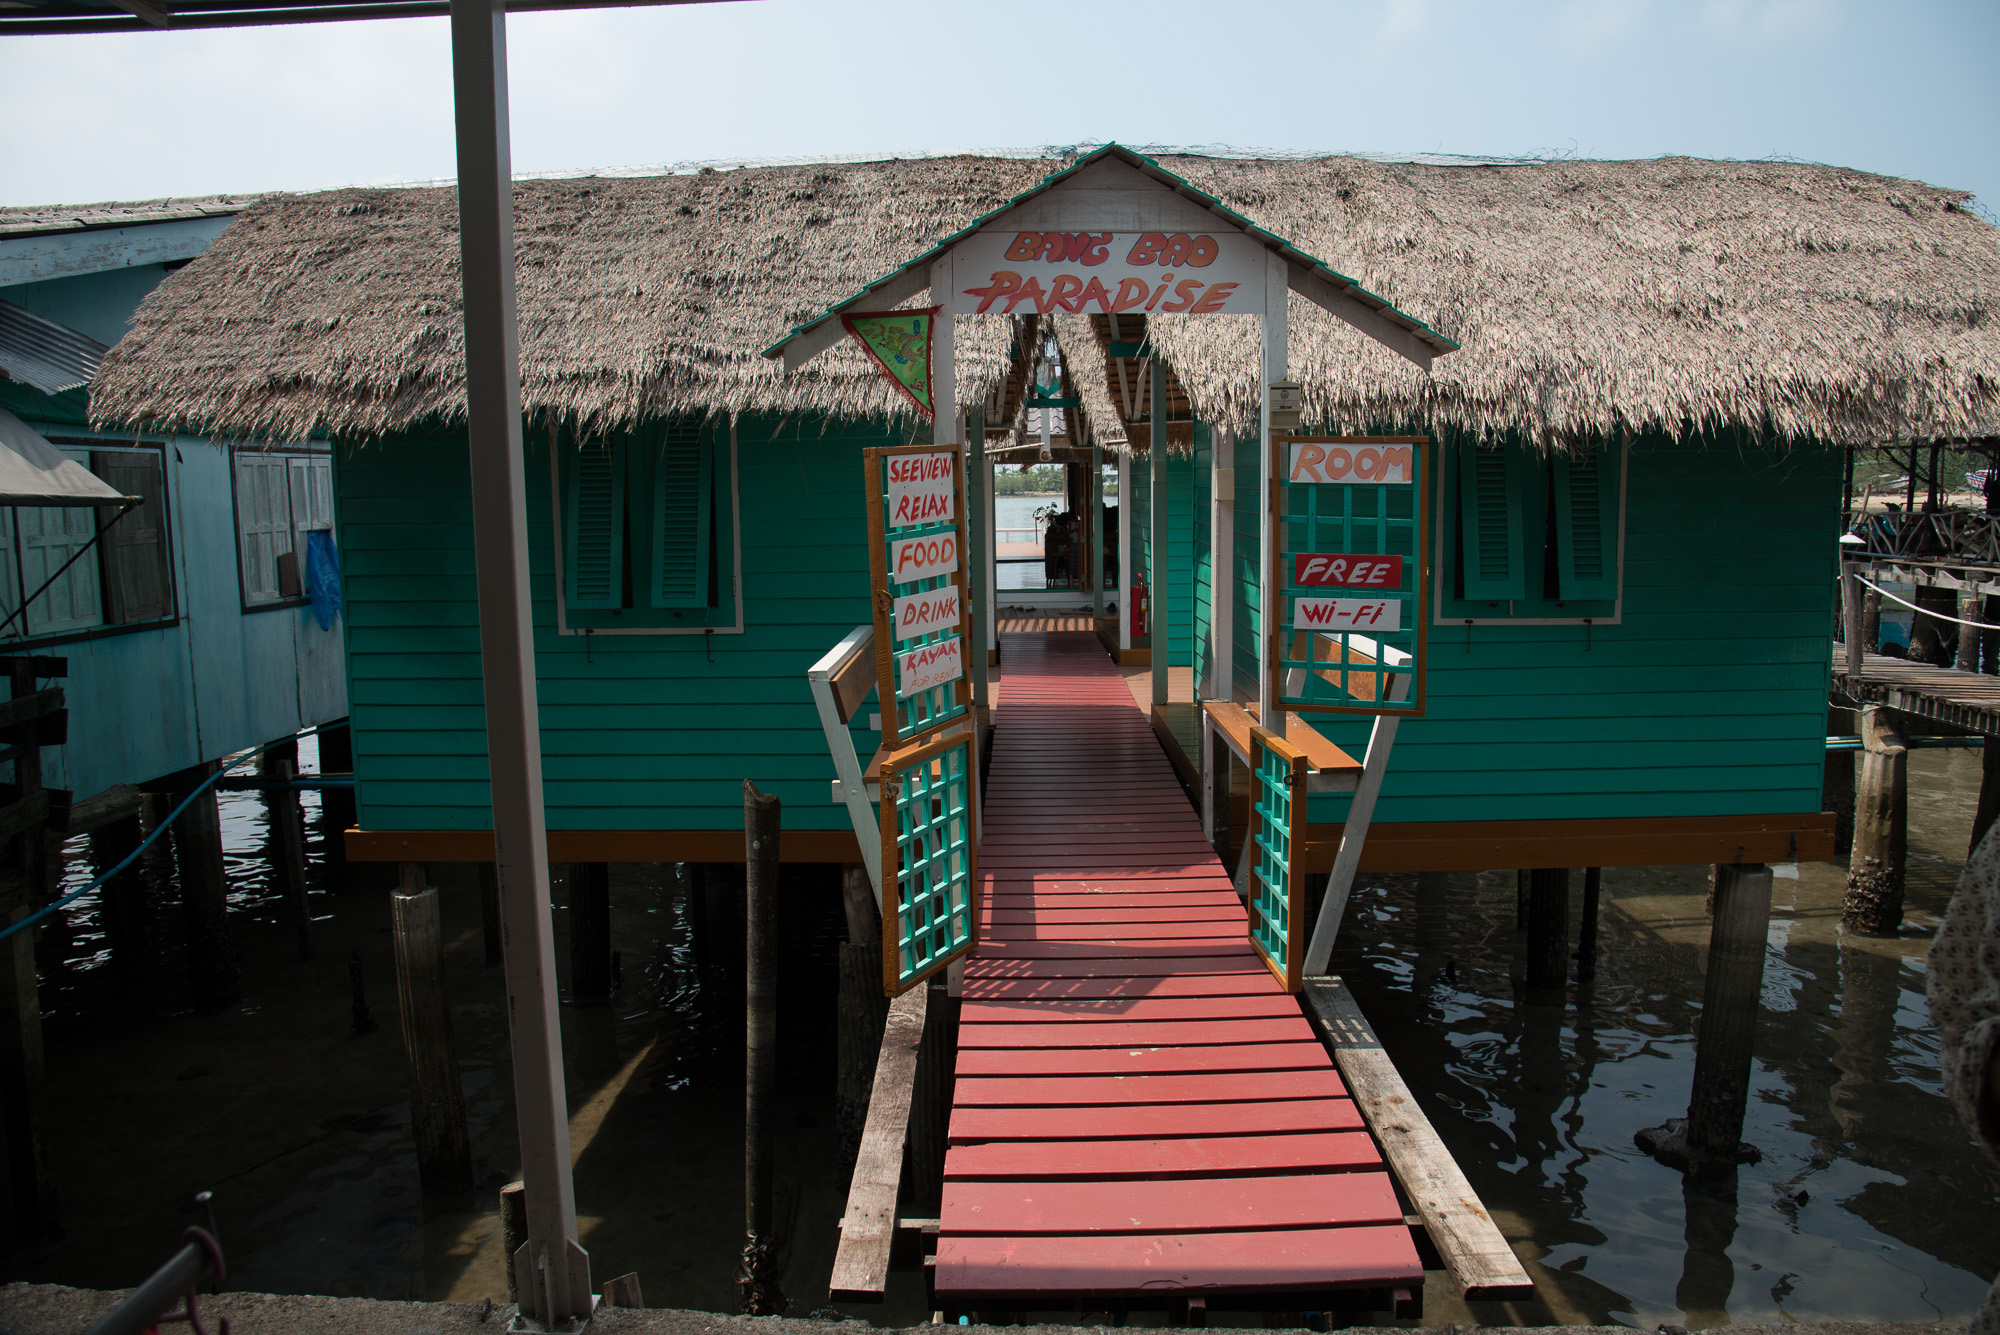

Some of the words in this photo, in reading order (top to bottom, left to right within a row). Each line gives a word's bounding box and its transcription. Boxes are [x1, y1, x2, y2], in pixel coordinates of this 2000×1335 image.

[1003, 232, 1113, 266] BANG
[1125, 232, 1219, 267] BAO
[1290, 443, 1413, 482] ROOM
[895, 493, 949, 523] RELAX
[898, 537, 955, 574] FOOD
[1300, 557, 1391, 583] FREE
[902, 596, 958, 626] DRINK
[1301, 600, 1386, 625] Wi-Fi
[906, 641, 958, 672] KAYAK
[908, 674, 930, 693] FOR
[932, 666, 957, 684] RENT
